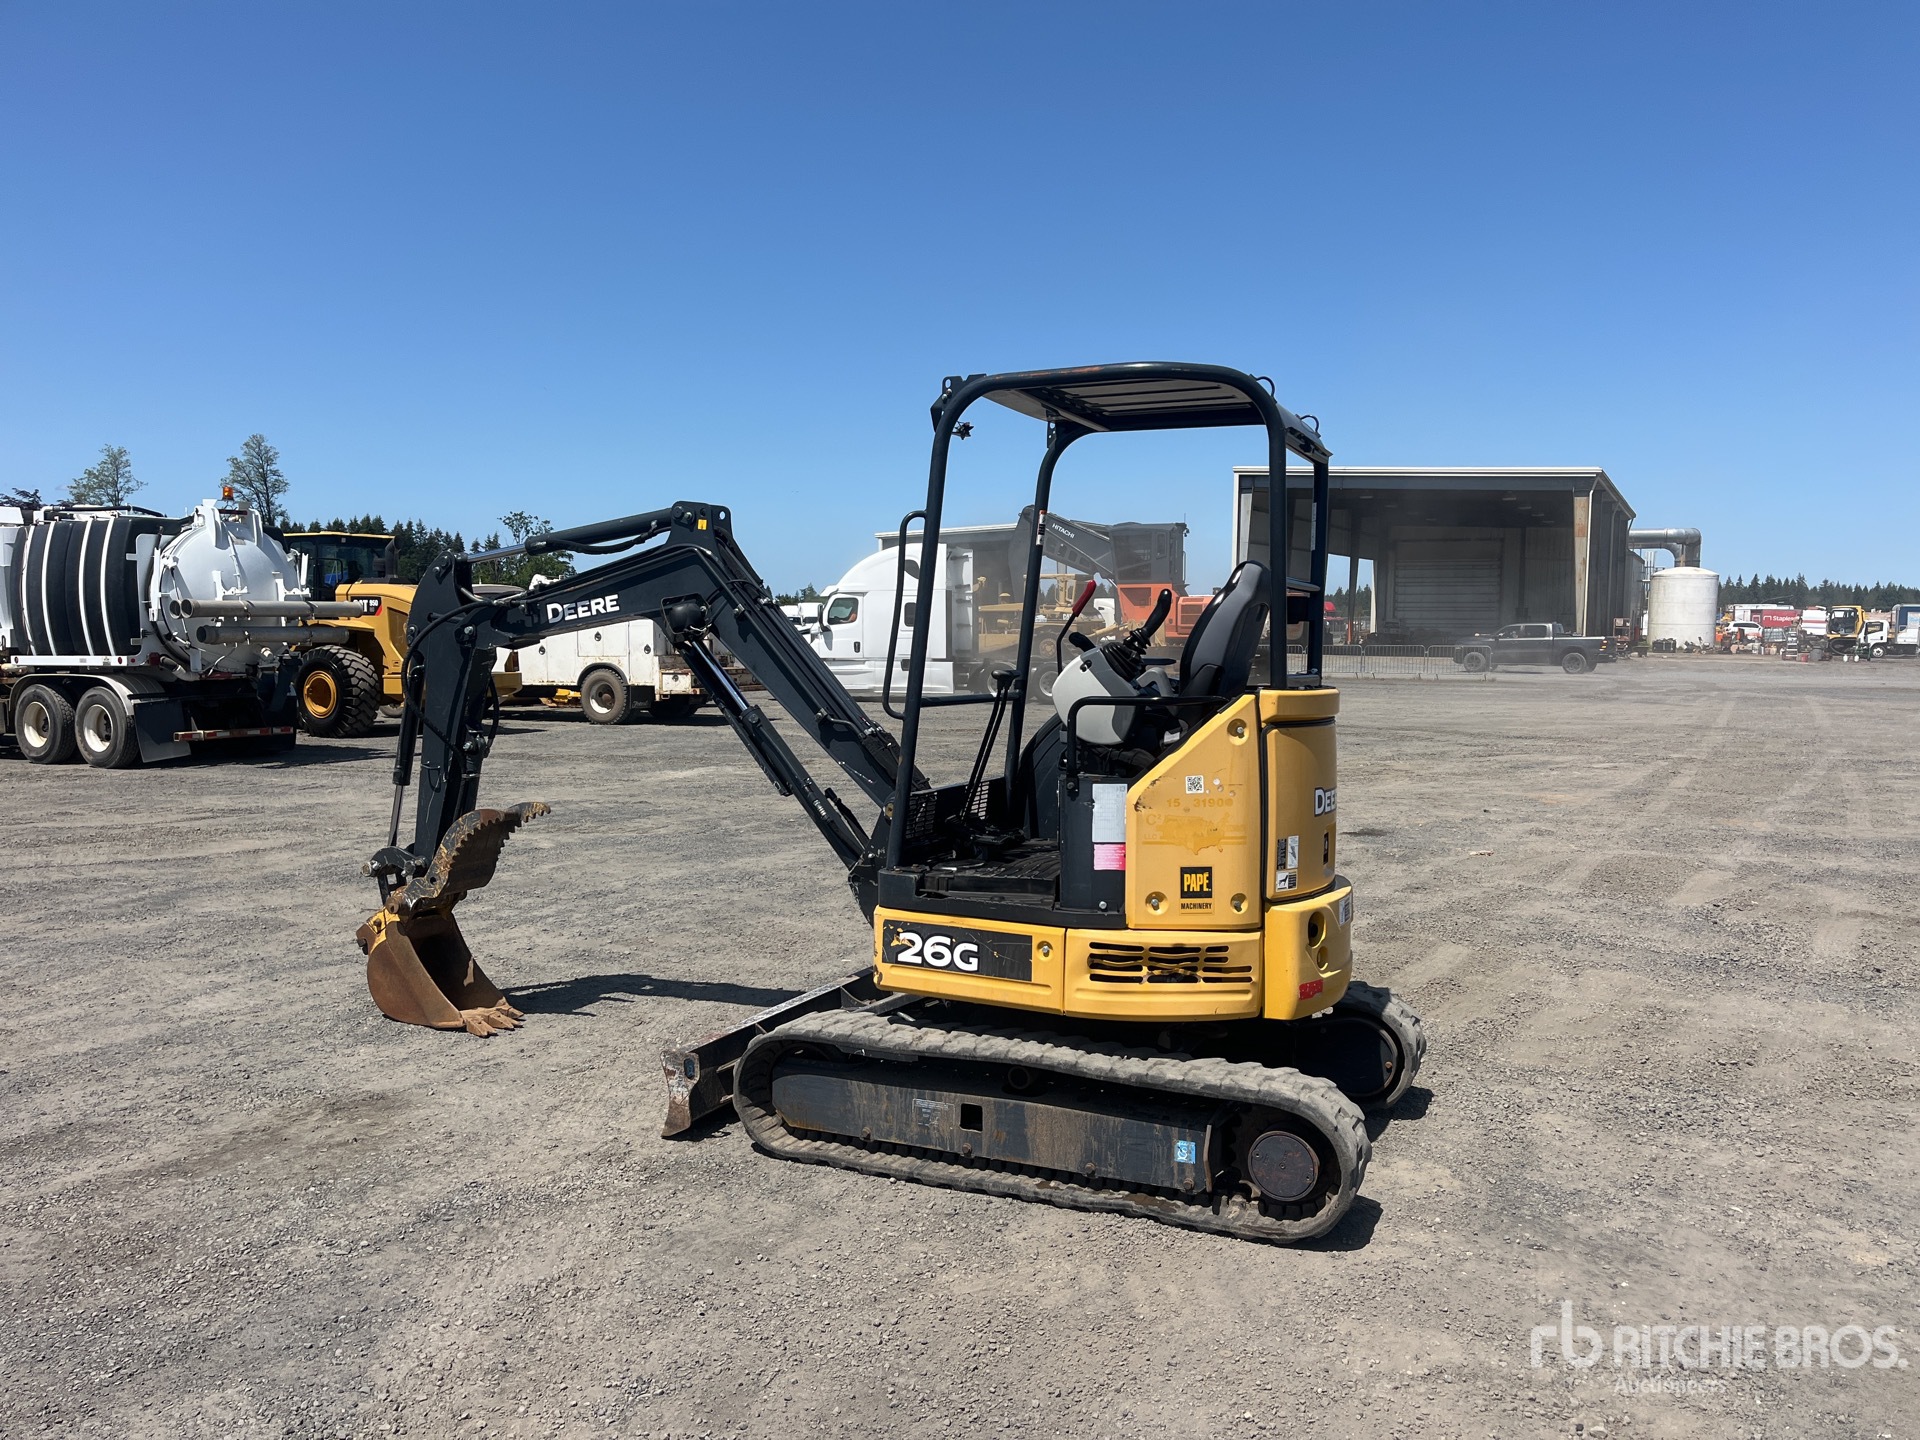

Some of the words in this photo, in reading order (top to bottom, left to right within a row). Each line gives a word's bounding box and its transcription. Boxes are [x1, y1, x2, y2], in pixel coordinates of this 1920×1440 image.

[1052, 523, 1075, 539] HITACHI
[546, 594, 620, 624] DEERE
[1193, 798, 1233, 807] 3190
[1314, 787, 1337, 817] DEE
[1181, 902, 1212, 910] MACHINERY
[896, 931, 979, 972] 26G
